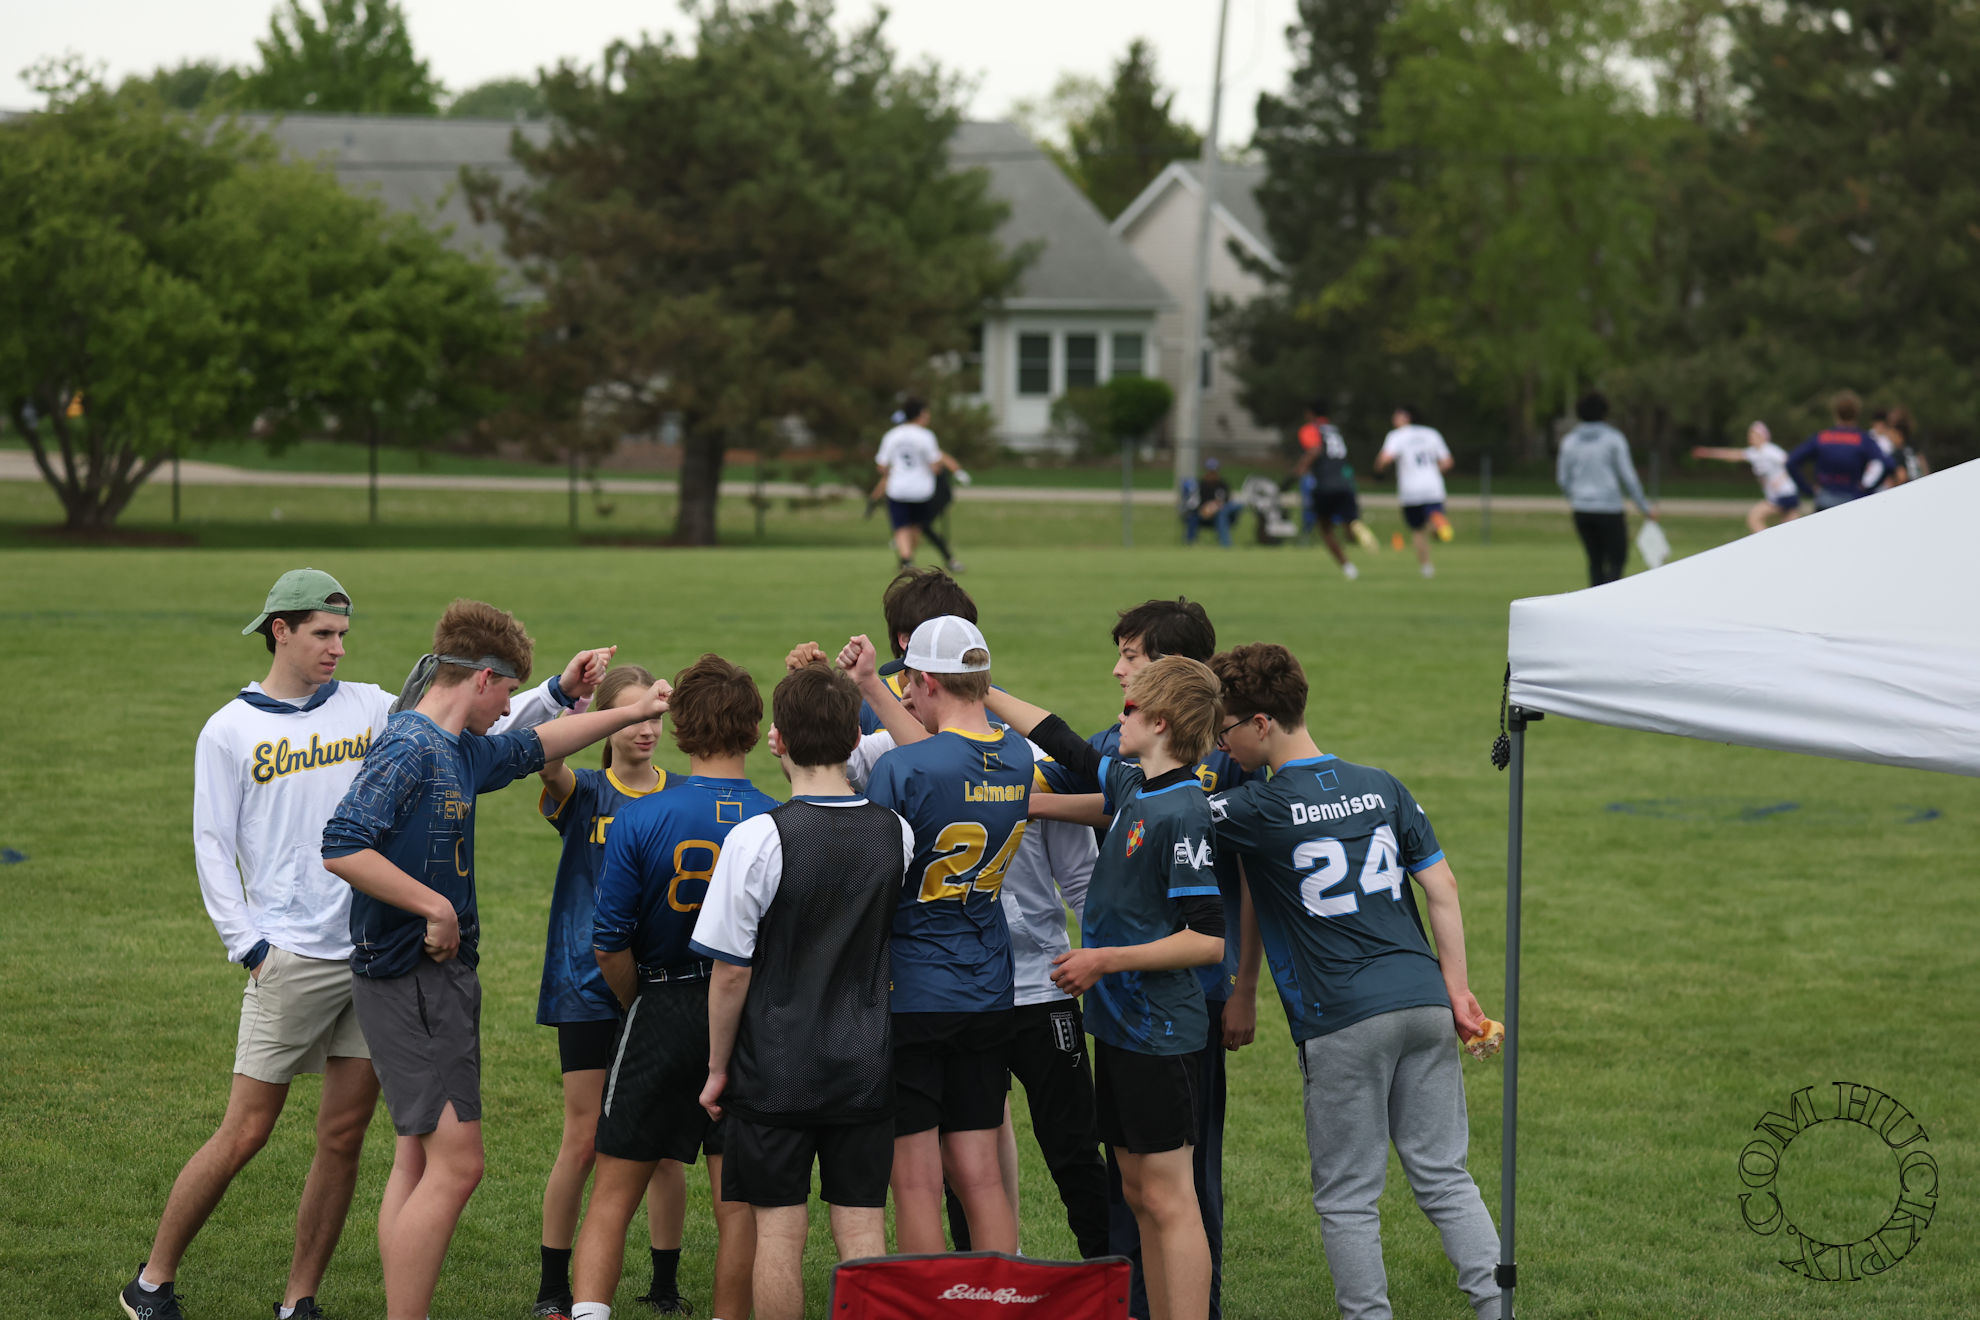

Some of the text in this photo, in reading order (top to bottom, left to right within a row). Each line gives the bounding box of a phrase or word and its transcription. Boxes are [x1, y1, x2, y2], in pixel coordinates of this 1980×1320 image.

[252, 726, 373, 784] Elmhurst
[964, 781, 1026, 802] Leiman
[1290, 793, 1386, 825] Dennison
[917, 818, 1028, 905] 24
[1292, 823, 1405, 918] 24
